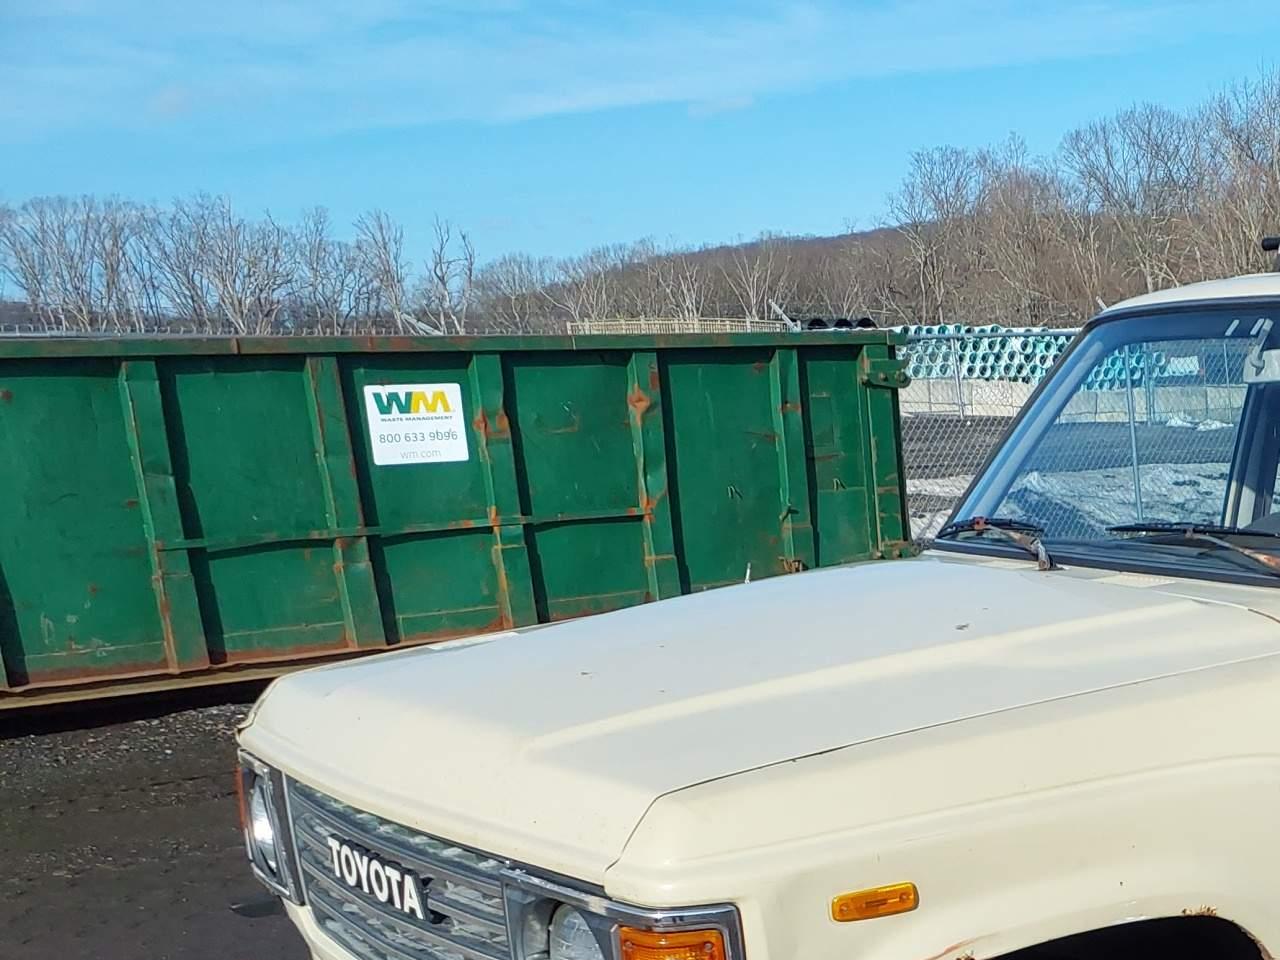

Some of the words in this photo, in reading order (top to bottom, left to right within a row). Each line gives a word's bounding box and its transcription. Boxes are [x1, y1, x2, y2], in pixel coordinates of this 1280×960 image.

[372, 390, 451, 415] WM
[379, 433, 401, 443] 800
[404, 432, 426, 442] 633
[400, 449, 442, 459] wm.com
[327, 836, 424, 920] TOYOTA
